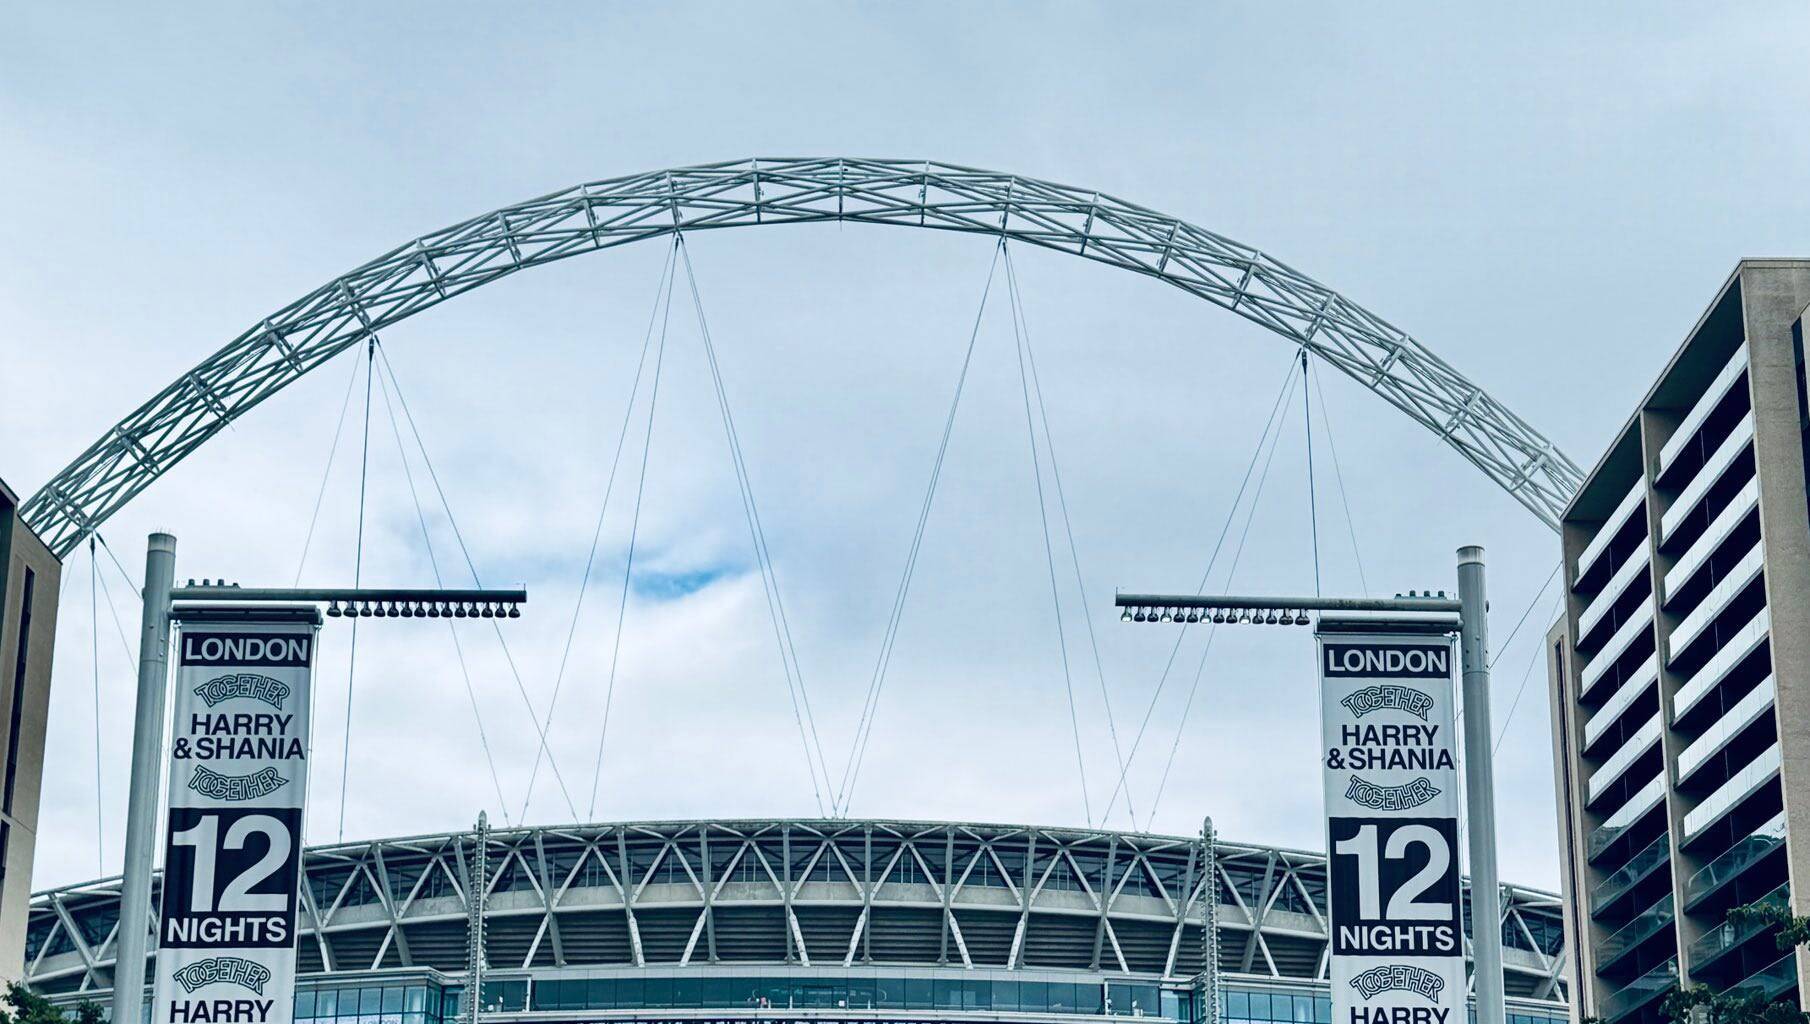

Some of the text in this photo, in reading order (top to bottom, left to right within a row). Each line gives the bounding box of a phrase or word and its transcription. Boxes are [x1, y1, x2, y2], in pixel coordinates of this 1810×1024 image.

[185, 637, 308, 662] LONDON
[1328, 649, 1447, 673] LONDON
[193, 673, 290, 711] TOGETHER
[1341, 685, 1434, 722] TOGETHER
[191, 713, 293, 735] HARRY
[1341, 724, 1439, 746] HARRY
[188, 764, 289, 801] TOGETHER
[1344, 774, 1442, 811] TOGETHER
[172, 814, 291, 912] 12
[1335, 824, 1453, 920] 12
[167, 917, 287, 943] NIGHTS
[1340, 925, 1454, 950] NIGHTS
[173, 956, 271, 996] TOGETHER
[1349, 965, 1444, 1004] TOGETHER
[169, 1000, 274, 1023] HARRY
